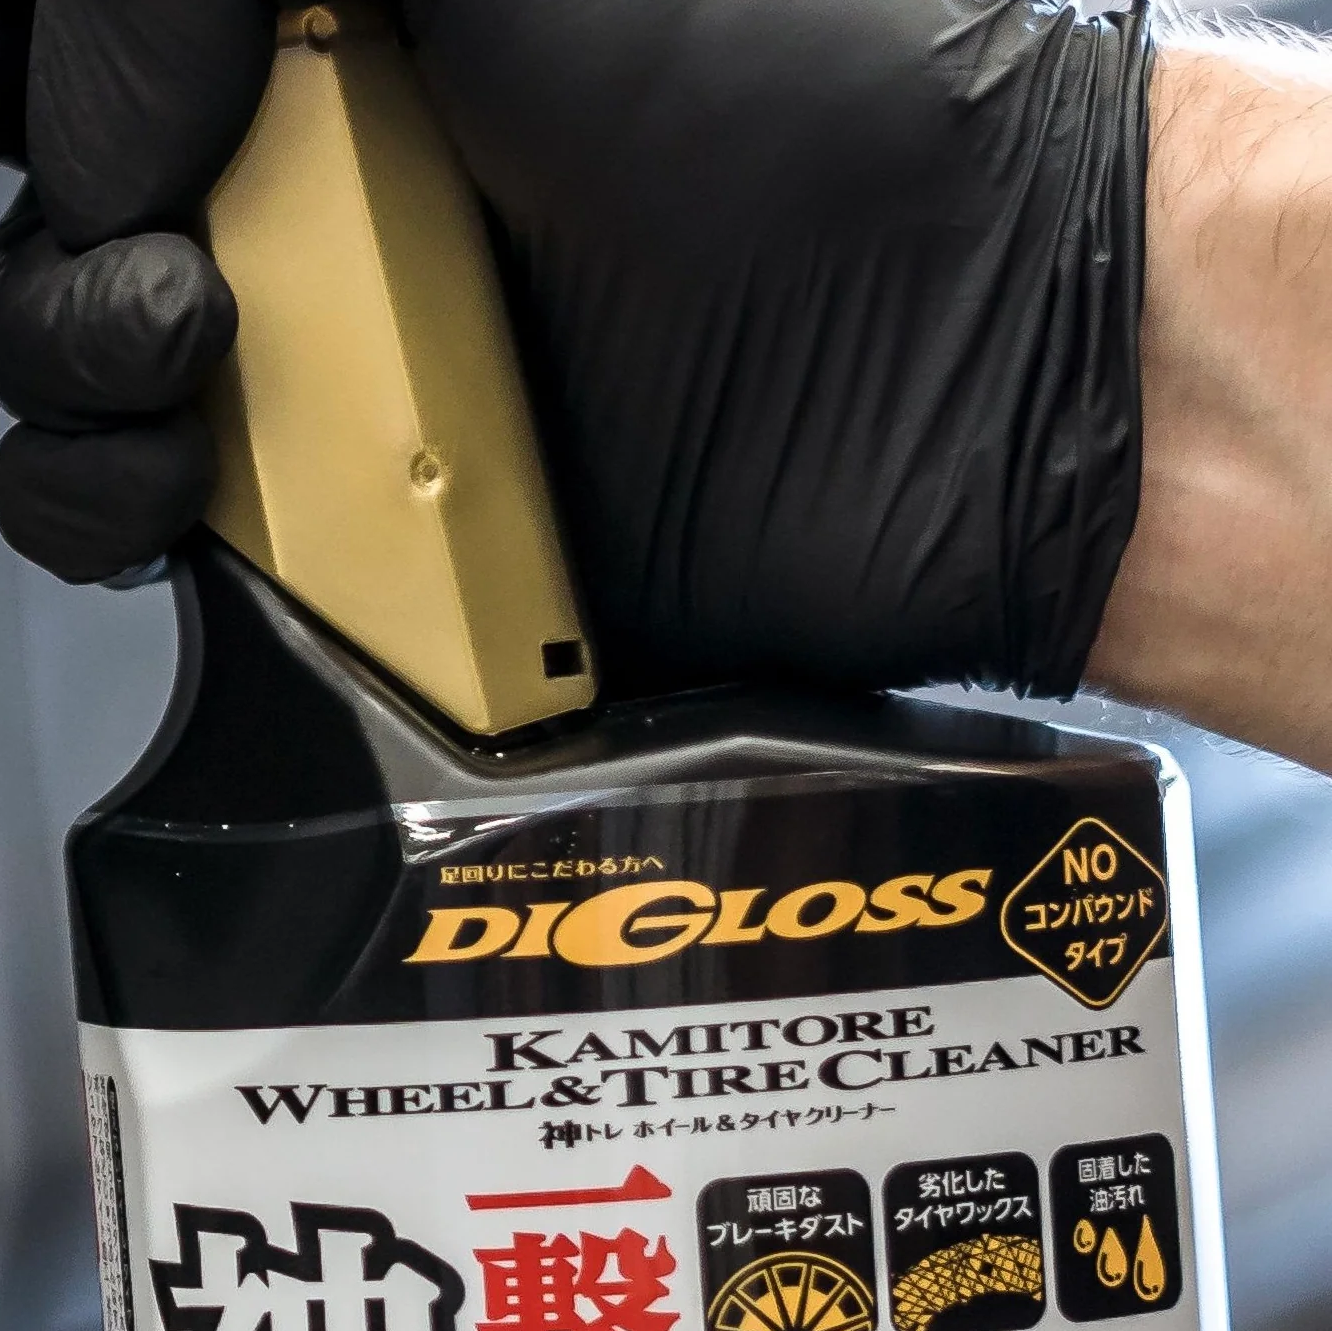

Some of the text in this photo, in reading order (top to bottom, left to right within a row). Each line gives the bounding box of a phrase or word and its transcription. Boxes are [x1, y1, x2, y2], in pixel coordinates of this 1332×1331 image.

[440, 855, 665, 884] 足回りにこだわる方へ
[1063, 843, 1117, 885] NO
[402, 867, 994, 967] DIGLOSS
[1025, 887, 1155, 931] コンパウンド
[1065, 932, 1128, 970] タイプ
[484, 1005, 935, 1072] KAMITORE
[917, 1167, 1007, 1197] 劣化した
[1077, 1152, 1152, 1183] 固着した
[747, 1185, 822, 1213] 頑固な
[894, 1195, 1034, 1232] タイヤワックス
[1089, 1184, 1145, 1213] 油汚れ
[707, 1213, 865, 1247] ブレーキダスト
